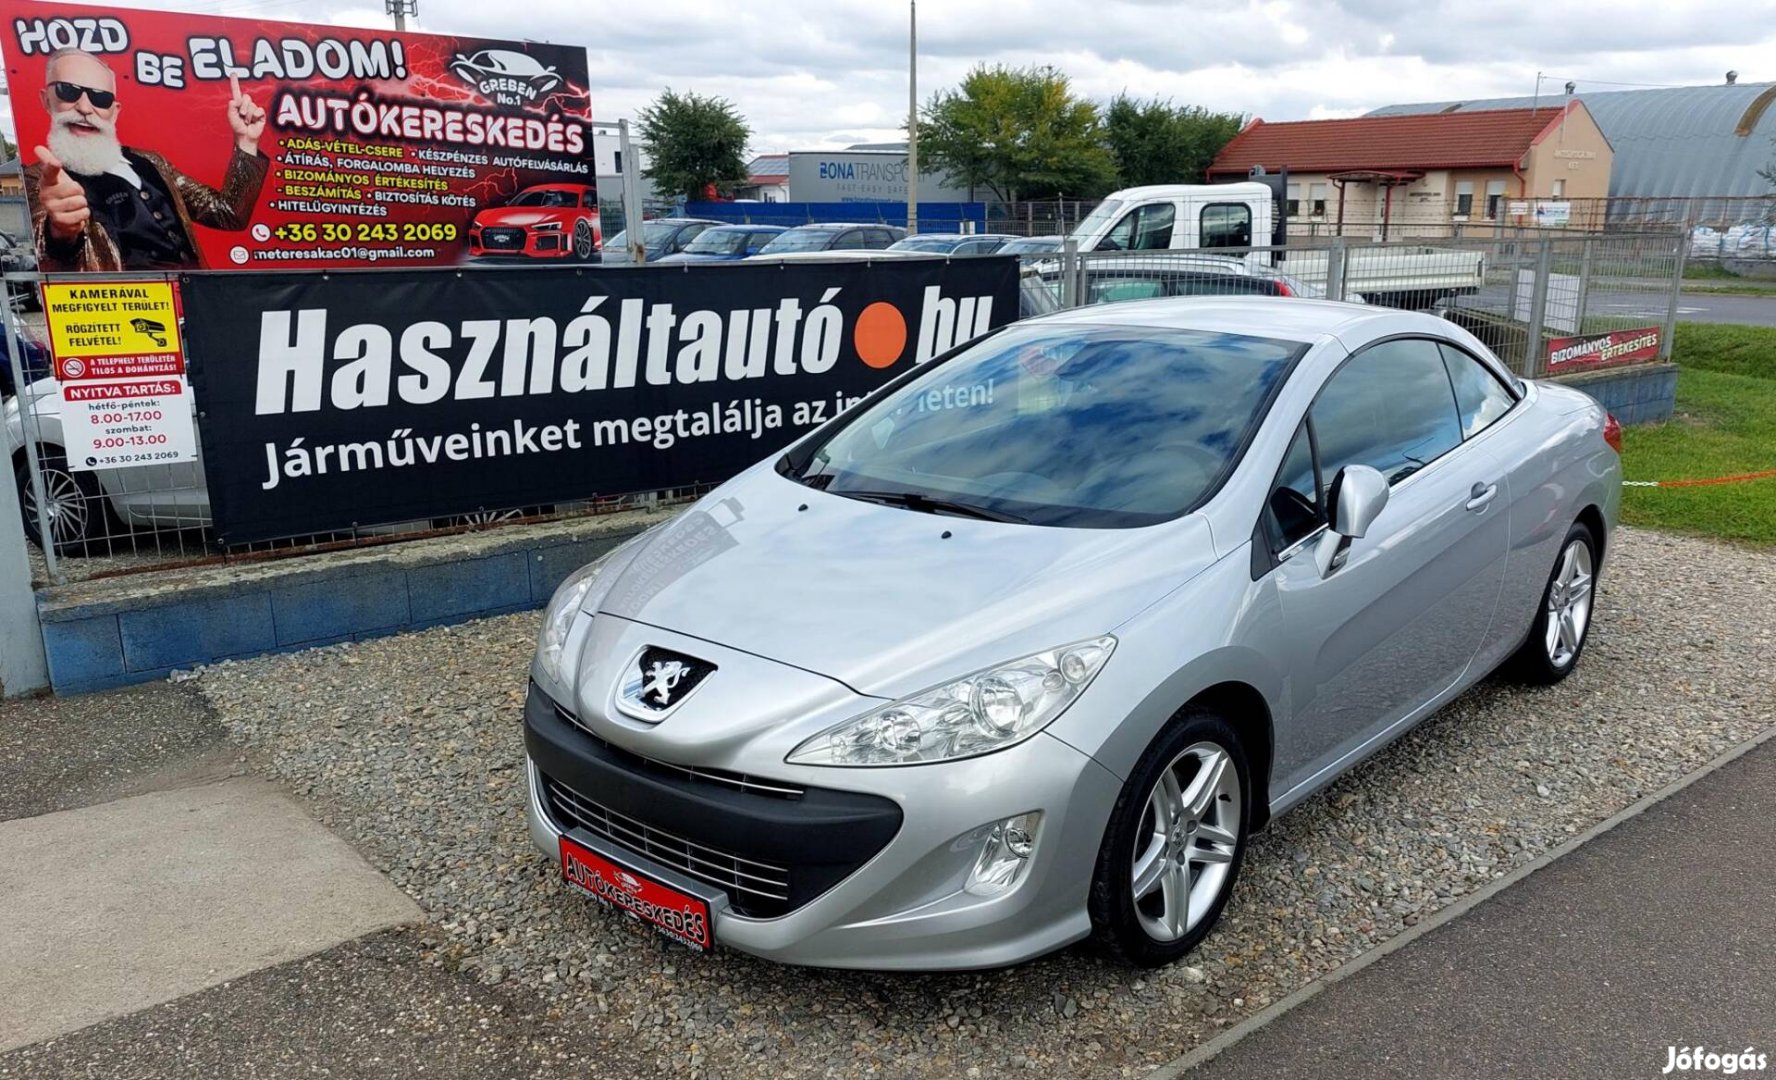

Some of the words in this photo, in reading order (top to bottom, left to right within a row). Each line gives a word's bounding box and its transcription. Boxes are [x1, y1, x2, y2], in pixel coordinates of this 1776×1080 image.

[16, 18, 128, 53] HOZD
[189, 38, 406, 79] ELADOM!
[136, 52, 184, 88] BE
[480, 78, 537, 100] GREBEN
[497, 92, 521, 106] No.1
[278, 94, 584, 154] AUTÓKERESKEDÉS
[287, 138, 403, 158] ADÁS-VÉTEL-CSERE
[284, 152, 333, 168] ÁTÍRÁS,
[337, 158, 420, 174] FORGALOMBA
[422, 164, 476, 179] HELYEZÉS
[418, 149, 488, 165] KÉSZPÉNZES
[493, 156, 588, 174] AUTÓFELVÁSÁRLÁS
[284, 169, 370, 185] BIZOMÁNYOS
[375, 173, 448, 190] ÉRTÉKESÍTÉS
[285, 185, 362, 200] BESZÁMÍTÁS
[375, 190, 440, 206] BIZTOSÍTÁS
[441, 193, 476, 207] KÖTÉS
[278, 200, 388, 216] HITELÜGYINTÉZÉS
[275, 224, 316, 242] +36
[322, 224, 351, 242] 30
[357, 224, 399, 242] 243
[404, 224, 457, 242] 2069
[70, 286, 149, 299] KAMERÁVAL
[52, 302, 117, 312] MEGFIGYELT
[122, 300, 169, 311] TERÜLET!
[66, 322, 120, 333] RÖGZÍTETT
[69, 335, 121, 346] FELVÉTEL!
[1550, 336, 1612, 364] BIZOMÁNYOS
[97, 356, 135, 366] TELEPHELY
[91, 366, 115, 375] TILOS
[118, 366, 123, 374] A
[70, 387, 122, 399] NYITVA
[123, 381, 175, 396] TARTÁS:
[90, 410, 162, 424] 8.00-17.00
[105, 424, 152, 435] szombat:
[93, 433, 167, 449] 9.00-13.00
[262, 418, 581, 490] Járműveinket
[593, 398, 782, 449] megtalálja
[793, 401, 827, 426] az
[99, 456, 117, 464] +36
[119, 454, 132, 463] 30
[134, 453, 152, 462] 243
[154, 451, 179, 460] 2069
[566, 852, 706, 944] AUTÓKERESKEDÉS
